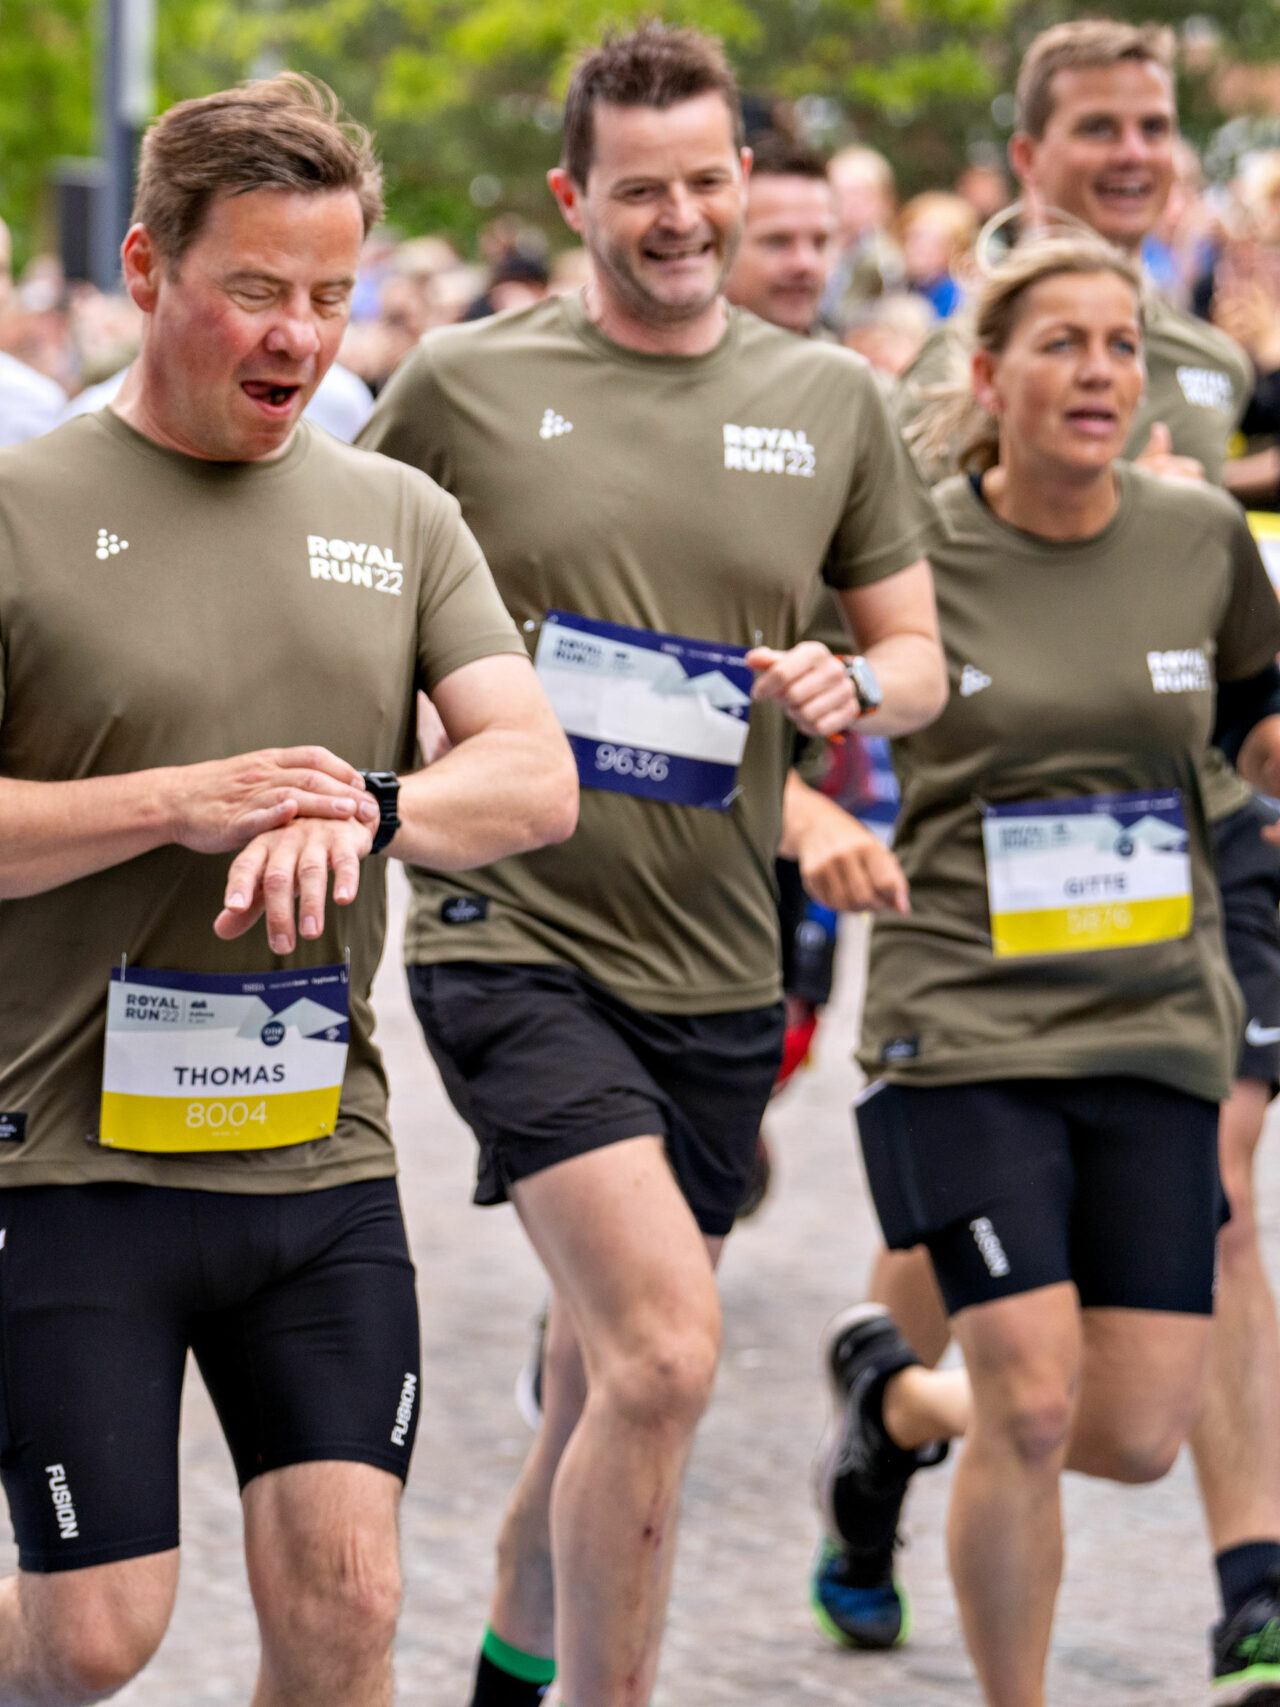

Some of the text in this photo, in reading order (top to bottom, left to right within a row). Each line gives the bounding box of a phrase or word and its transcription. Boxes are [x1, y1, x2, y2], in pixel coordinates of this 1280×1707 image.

[723, 423, 815, 453] ROYAL
[307, 534, 404, 571] ROYAL
[594, 743, 670, 782] 9636
[1064, 871, 1128, 898] GITTE
[126, 993, 180, 1009] ROYAL
[174, 1063, 286, 1086] THOMAS
[185, 1100, 268, 1128] 8004
[389, 1372, 418, 1447] FUSION
[45, 1463, 80, 1539] FUSION
